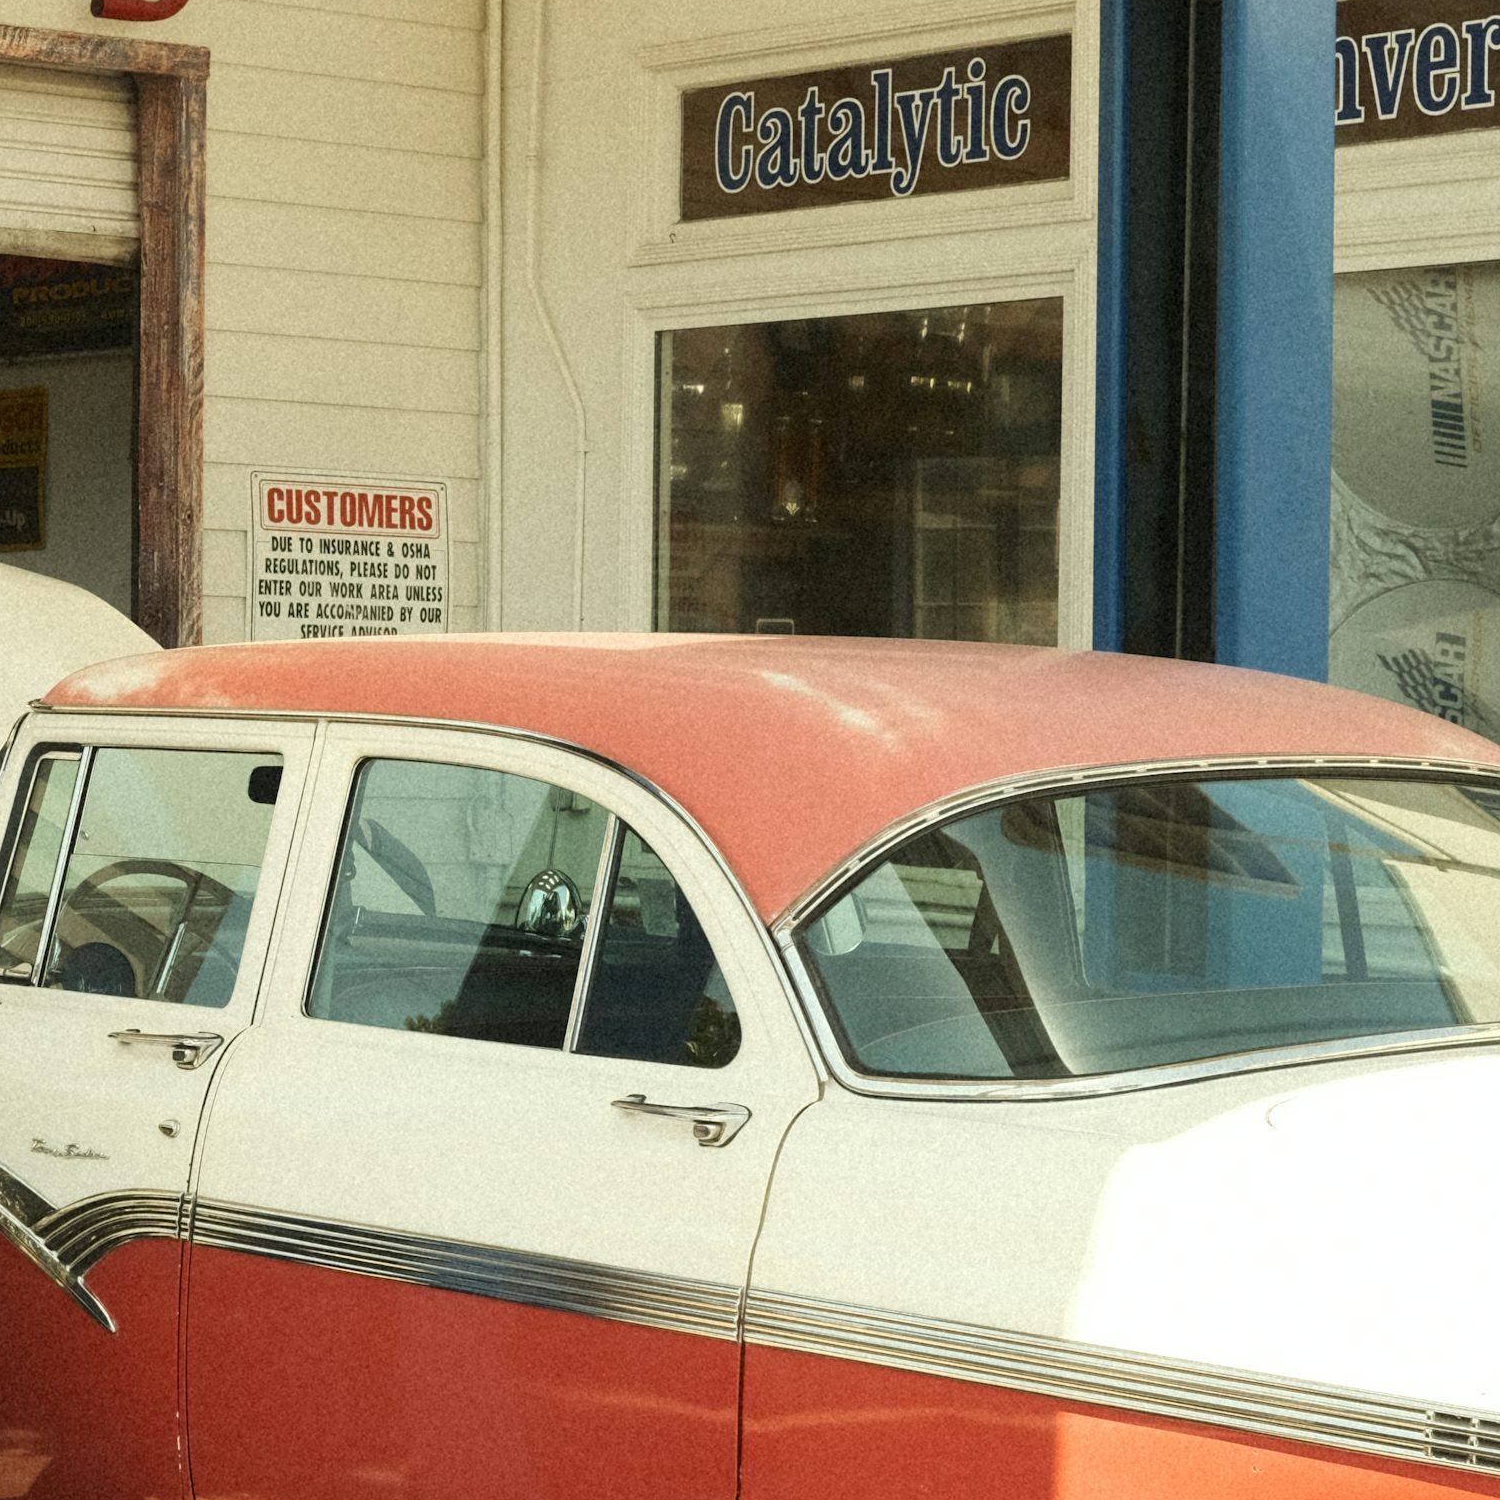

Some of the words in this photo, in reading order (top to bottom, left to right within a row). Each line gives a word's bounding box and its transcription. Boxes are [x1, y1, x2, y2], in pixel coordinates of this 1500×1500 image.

[1335, 15, 1500, 126] nver
[715, 57, 1032, 196] Catalytic
[267, 487, 433, 531] CUSTOMERS
[271, 536, 293, 553] DUE
[299, 537, 313, 554] TO
[319, 538, 380, 557] INSURANCE
[386, 541, 395, 558] &
[401, 542, 431, 559] OSHA
[265, 557, 343, 580] REGULATIONS,
[350, 561, 388, 579] PLEASE
[394, 563, 410, 580] DO
[416, 564, 437, 581] NOT
[258, 579, 292, 596] ENTER
[299, 580, 322, 597] OUR
[329, 581, 363, 599] WORK
[370, 583, 399, 600] AREA
[405, 585, 443, 602] UNLESS
[259, 601, 281, 618] YOU
[288, 602, 310, 619] ARE
[316, 603, 394, 621] ACCOMPANIED
[400, 606, 413, 622] BY
[420, 607, 442, 624] OUR
[300, 624, 344, 639] SERVICE
